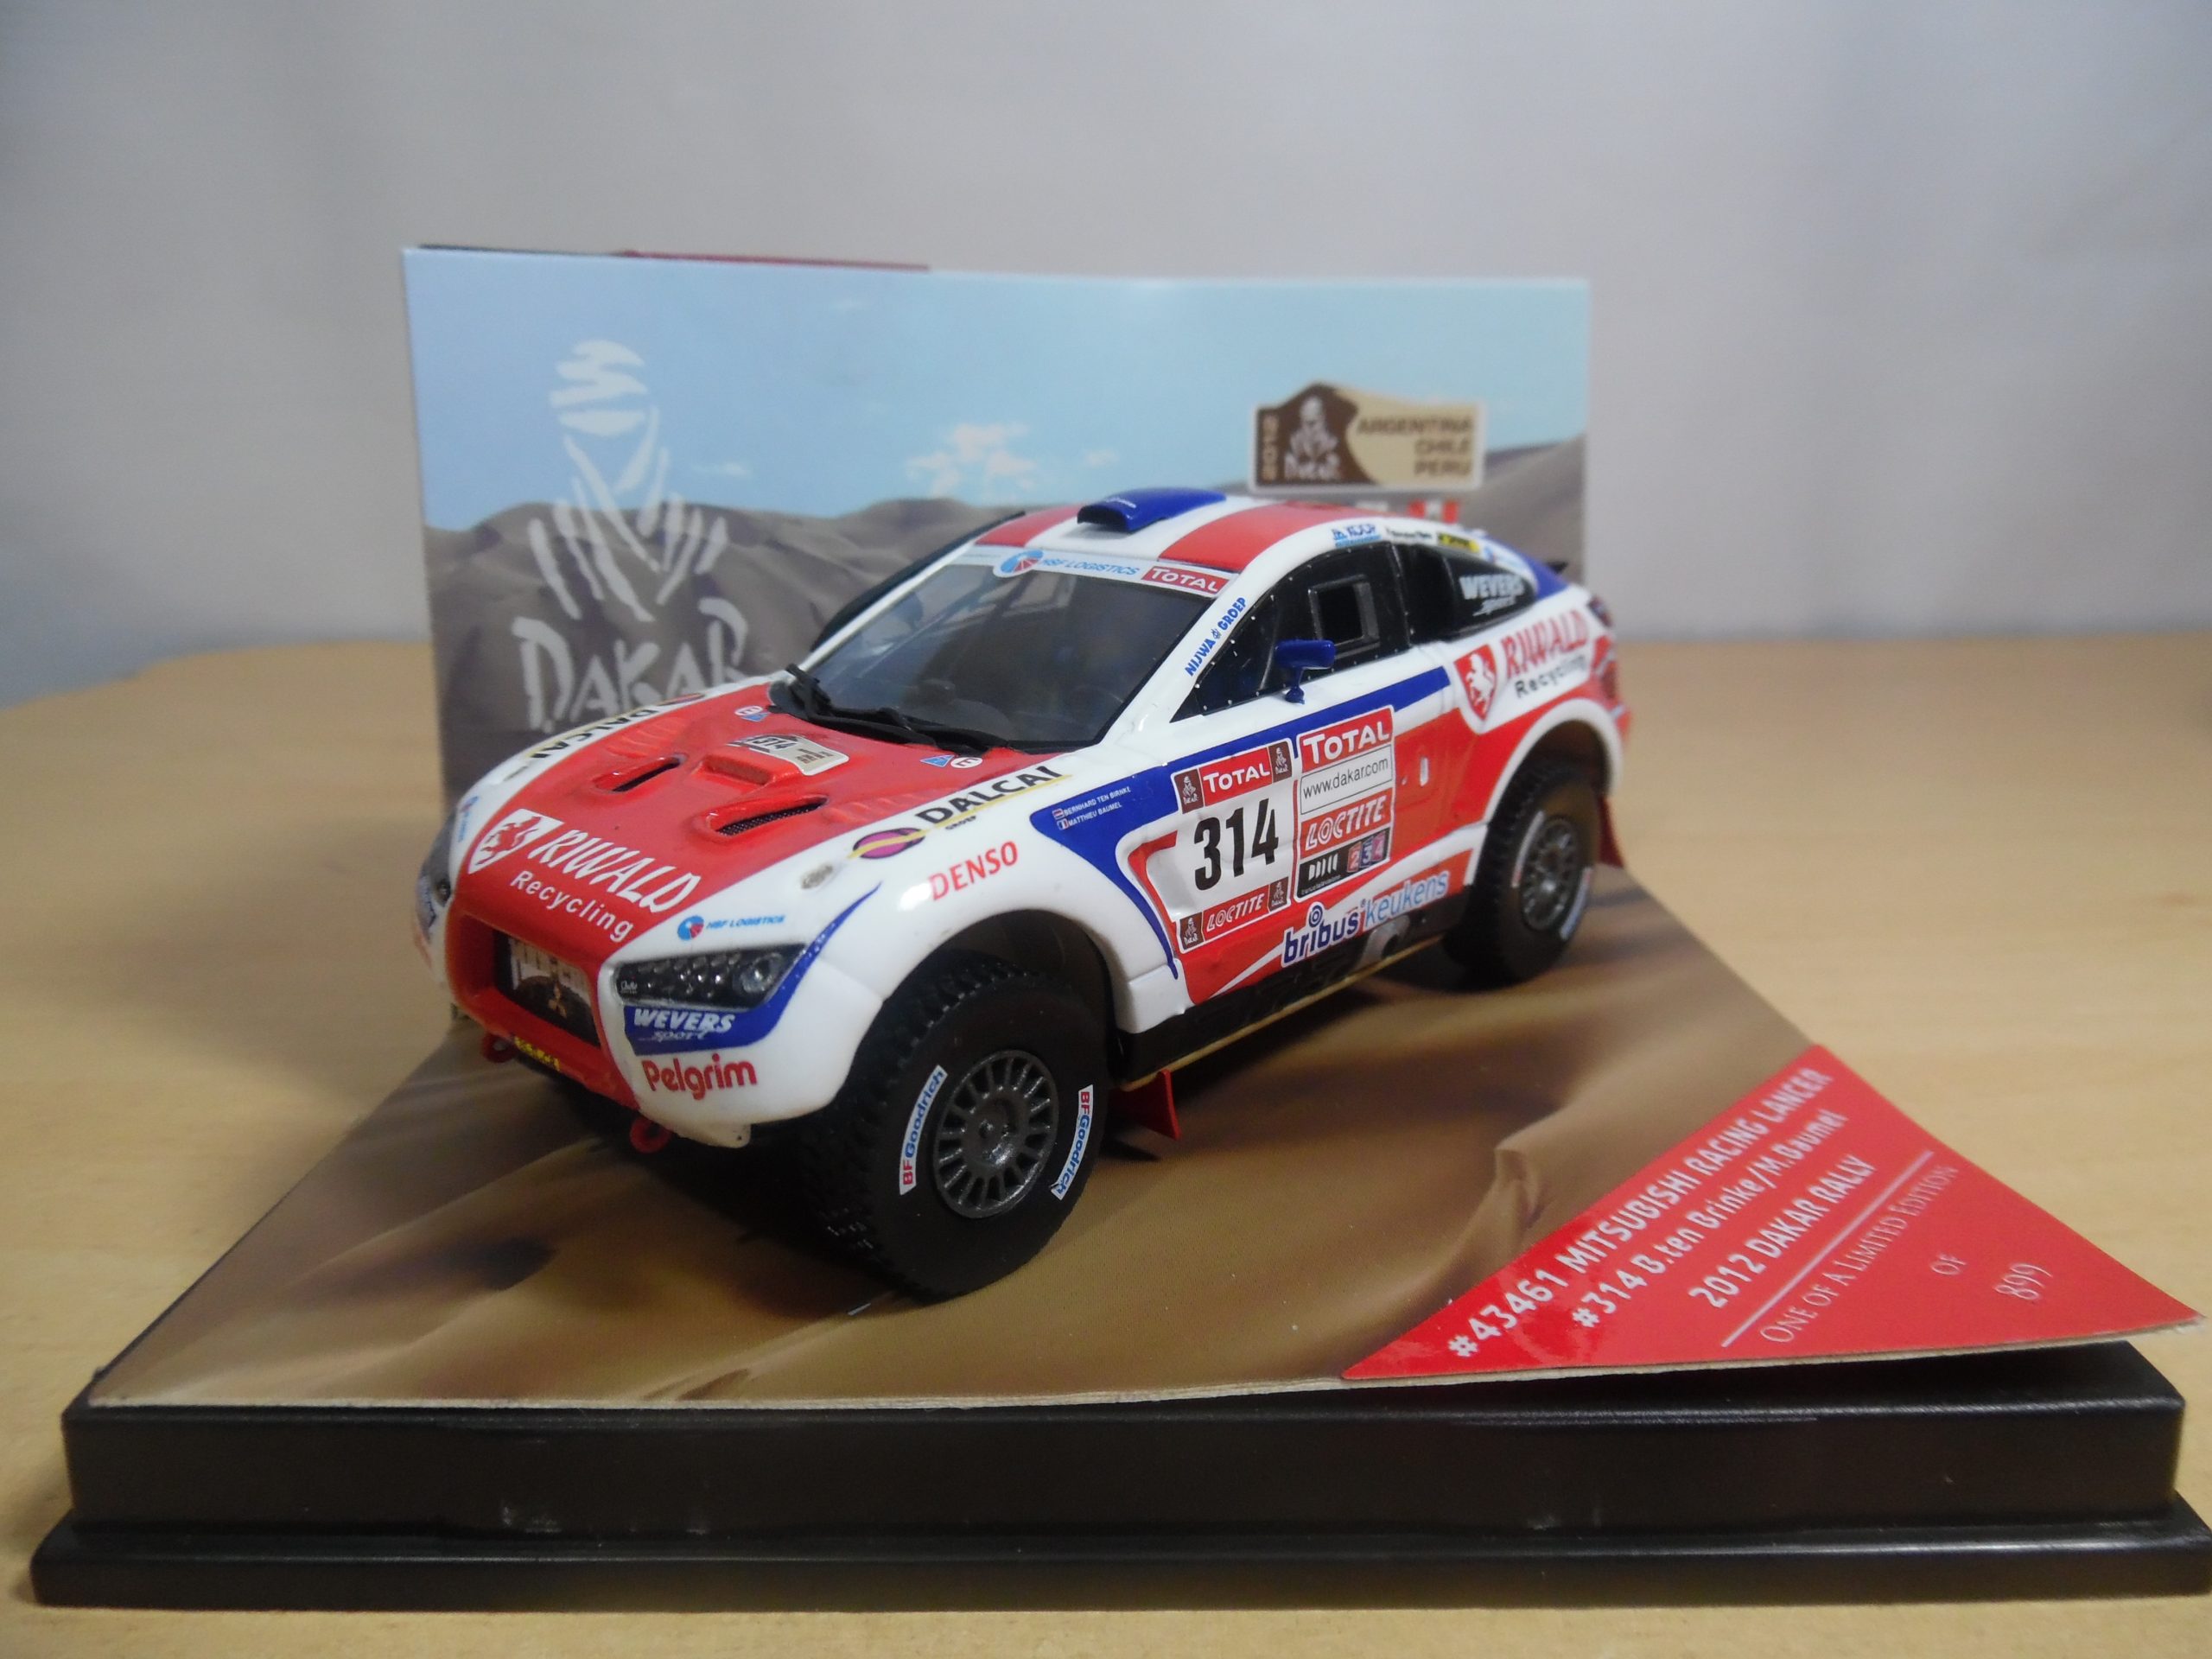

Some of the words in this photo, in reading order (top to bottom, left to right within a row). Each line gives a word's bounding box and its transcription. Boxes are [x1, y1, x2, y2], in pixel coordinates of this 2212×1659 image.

[1065, 561, 1141, 575] LOGISTICS
[1145, 567, 1220, 593] TOTAL
[1185, 638, 1217, 677] NIJWA
[1217, 597, 1247, 632] GROEP
[512, 598, 749, 733] DAKAR
[1302, 720, 1390, 765] TOTAL
[1202, 763, 1270, 793] TOTAL
[1302, 756, 1389, 799] www.dakar.com
[1064, 798, 1096, 817] BERNHARD
[1096, 794, 1109, 804] TEN
[1068, 810, 1097, 827] MATTHIEU
[1097, 802, 1122, 816] BAUMEL
[1305, 795, 1388, 851] LOCTITE
[527, 829, 702, 913] RIWALD
[928, 841, 1019, 900] DENSO
[1194, 798, 1279, 891] 314
[510, 870, 634, 943] Recycling
[729, 914, 785, 928] LOGISTICS
[1206, 893, 1265, 932] LOCTITE
[1365, 873, 1450, 927] keukens
[634, 1008, 735, 1033] WEVERS
[641, 1053, 757, 1101] Pelgrim
[902, 1070, 944, 1185] BFGoodrich
[1056, 1091, 1090, 1195] BFGoodrich
[1448, 1268, 1569, 1357] #43461
[1555, 1169, 1701, 1274] MITSUBISHI
[1685, 1117, 1770, 1177] RACING
[1751, 1067, 1834, 1123] LANCER
[1688, 1253, 1767, 1309] 2012
[1744, 1198, 1831, 1259] DAKAR
[1809, 1154, 1878, 1203] RALLY
[1572, 1269, 1648, 1328] #314
[1632, 1227, 1706, 1275] B.ten
[1759, 1306, 1820, 1344] ONE
[1802, 1283, 1840, 1307] OF
[1823, 1262, 1857, 1287] A
[1844, 1205, 1910, 1273] LIMITED
[1889, 1164, 1960, 1217] EDITION
[1929, 1252, 1967, 1275] OF
[1993, 1262, 2054, 1300] 899
